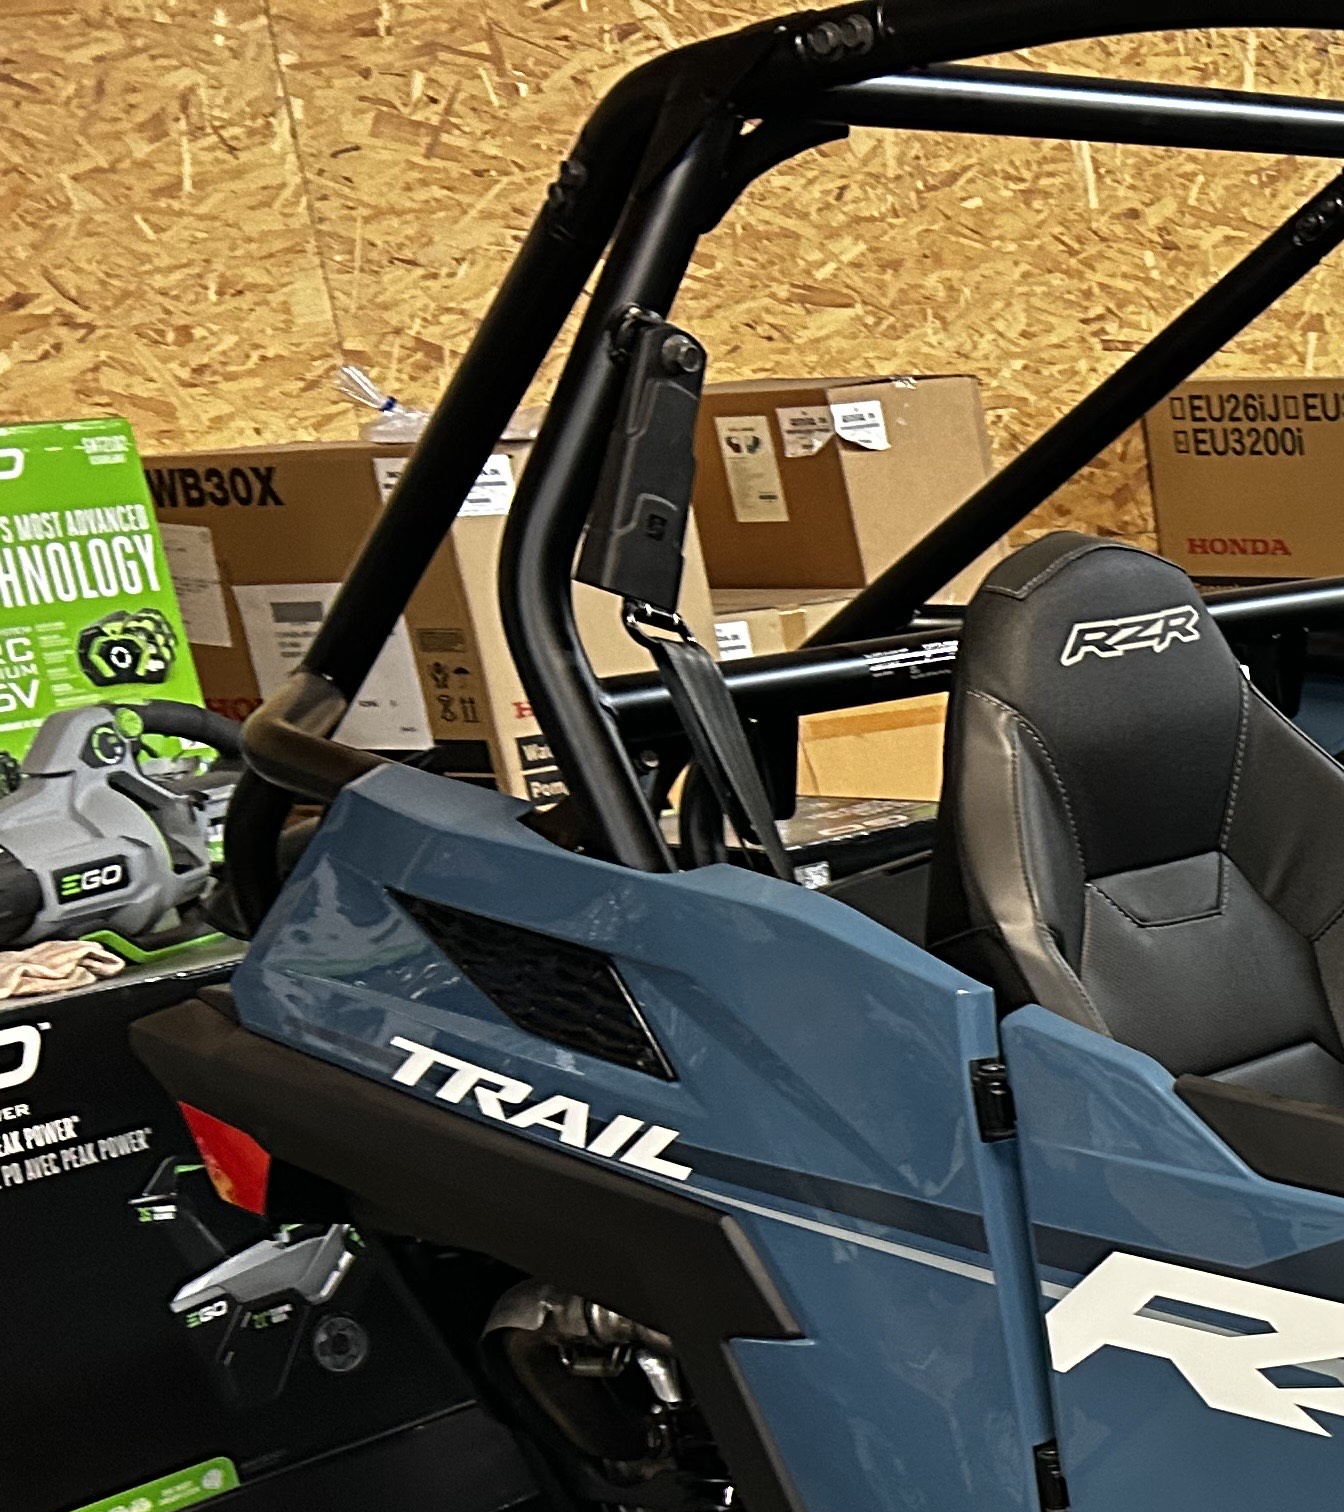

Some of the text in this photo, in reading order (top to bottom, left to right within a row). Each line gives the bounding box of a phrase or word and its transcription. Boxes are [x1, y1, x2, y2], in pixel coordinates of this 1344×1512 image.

[1193, 427, 1305, 456] EU3200i
[13, 510, 63, 541] MOST
[65, 504, 150, 537] ADVANCED
[1187, 538, 1292, 556] HONDA
[1060, 604, 1200, 667] RZR
[61, 865, 122, 896] EGO
[390, 1035, 694, 1181] TRAIL
[23, 1117, 78, 1150] POWER
[60, 1143, 99, 1171] PEAK
[97, 1129, 150, 1161] POWER
